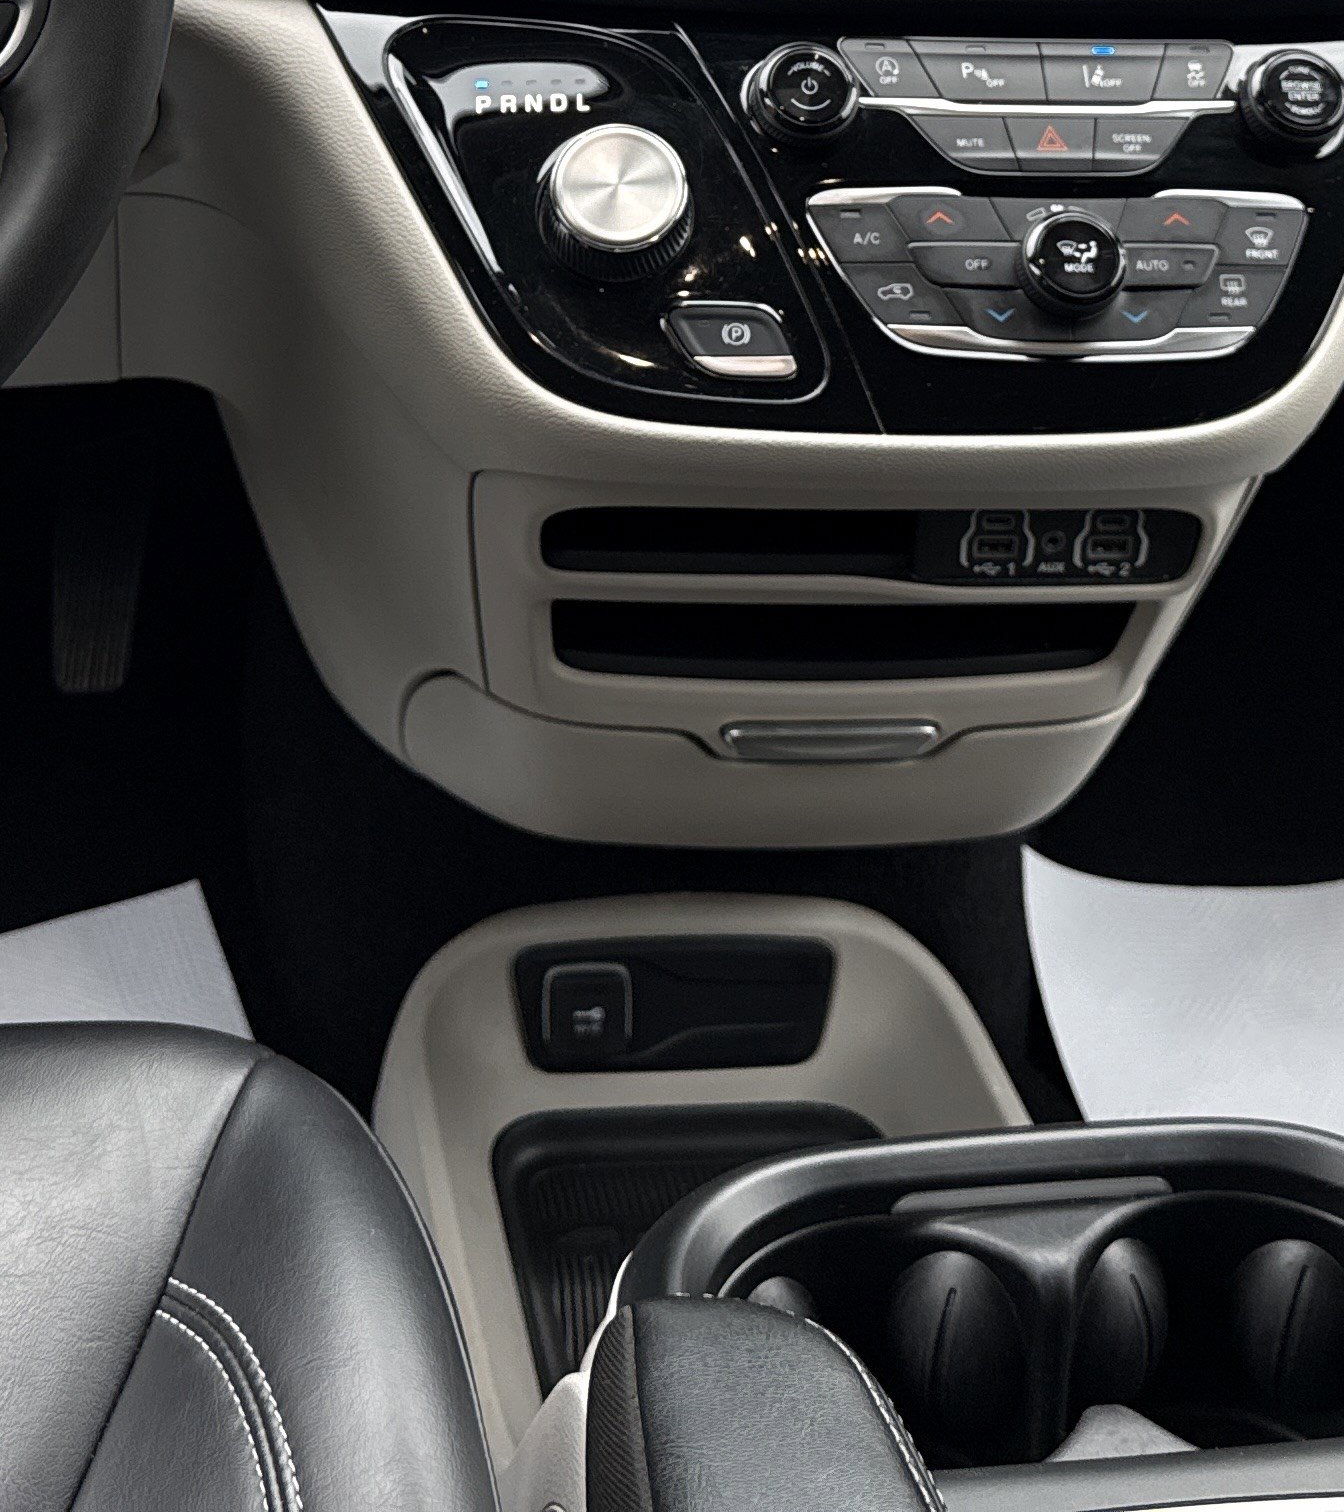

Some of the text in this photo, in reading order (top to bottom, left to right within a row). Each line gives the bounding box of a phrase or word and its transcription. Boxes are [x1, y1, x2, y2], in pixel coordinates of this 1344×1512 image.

[879, 76, 898, 85] OFF
[986, 78, 1005, 88] OFF
[1187, 78, 1206, 88] OFF
[956, 138, 985, 148] MUTE
[1112, 133, 1152, 144] SCREEN
[1122, 143, 1143, 153] OFF
[853, 232, 881, 246] A/C
[1245, 248, 1280, 260] FRONT
[965, 259, 988, 271] OFF
[1064, 262, 1095, 274] MODE
[1136, 259, 1169, 271] AUTO
[1221, 297, 1248, 307] REAR
[1008, 562, 1016, 577] 1
[1037, 561, 1066, 574] AUX
[1119, 561, 1131, 577] 2
